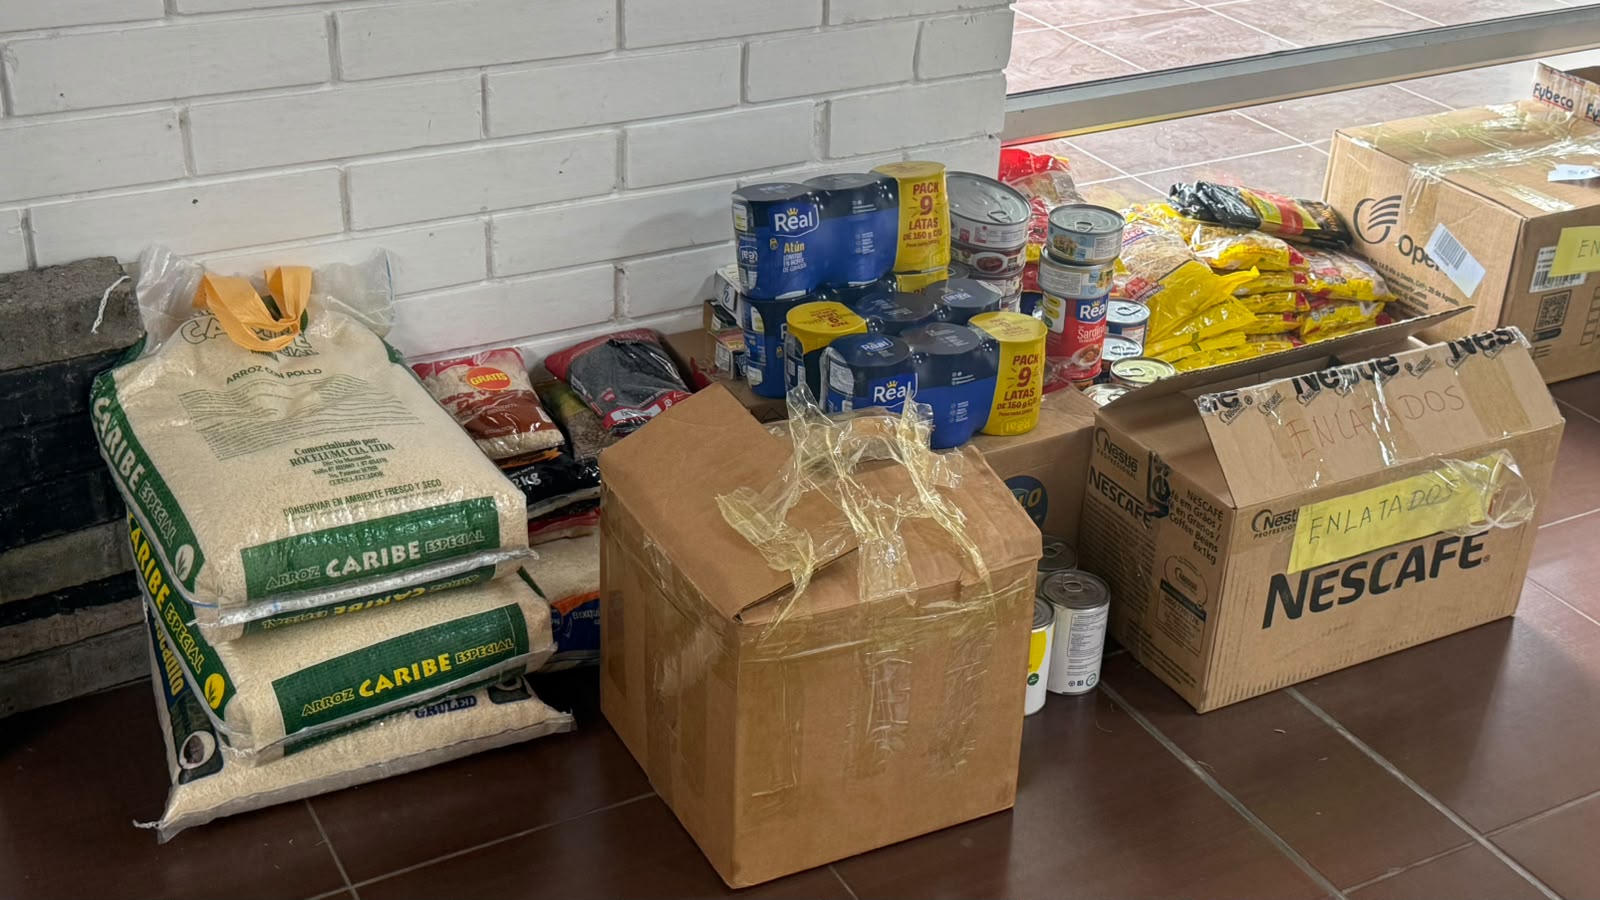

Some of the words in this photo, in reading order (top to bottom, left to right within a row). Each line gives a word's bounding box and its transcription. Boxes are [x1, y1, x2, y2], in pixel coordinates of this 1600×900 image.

[1533, 83, 1574, 108] Fybeca
[913, 182, 939, 194] PACK
[920, 195, 933, 215] 9
[774, 211, 813, 232] Real
[909, 218, 939, 230] LATAS
[784, 241, 805, 254] Atún
[1012, 354, 1039, 365] PACK
[226, 365, 264, 384] ARROZ
[286, 368, 322, 379] POLLO
[470, 372, 508, 385] GRATIS
[1016, 367, 1031, 388] 9
[1004, 388, 1035, 401] LATAS
[289, 449, 349, 467] ROCELUMA
[368, 443, 395, 453] LTDA
[294, 439, 361, 455] Comercializado
[361, 438, 380, 448] por:
[93, 397, 147, 493] CARIBE
[138, 480, 176, 547] ESPECIAL
[283, 500, 331, 518] CONSERVAR
[333, 498, 344, 509] EN
[344, 491, 384, 506] AMBIENTE
[384, 485, 415, 497] FRESCO
[422, 478, 442, 489] SECO
[1309, 480, 1458, 544] ENLATADOS
[1169, 513, 1194, 536] Coffee
[265, 566, 320, 590] ARROZ
[325, 540, 421, 578] CARIBE
[425, 530, 485, 553] ESPECIAL
[1193, 542, 1216, 565] 6x1kg
[163, 602, 205, 675] ESPECIAL
[301, 688, 355, 717] ARROZ
[359, 653, 452, 698] CARIBE
[455, 638, 515, 664] ESPECIAL
